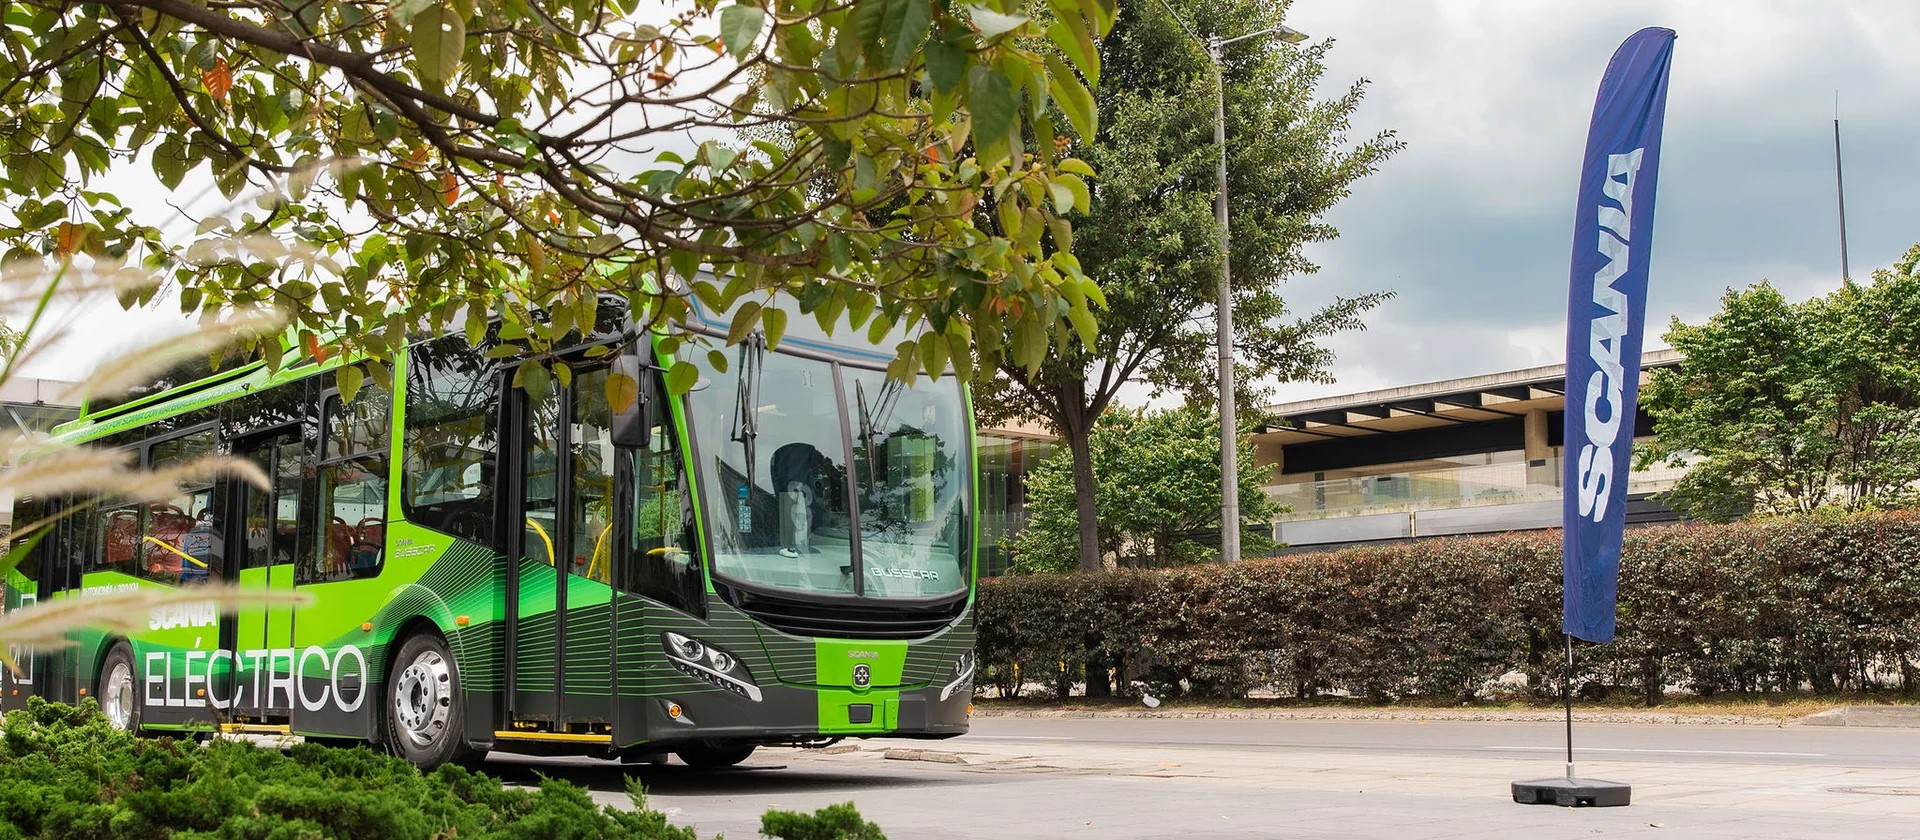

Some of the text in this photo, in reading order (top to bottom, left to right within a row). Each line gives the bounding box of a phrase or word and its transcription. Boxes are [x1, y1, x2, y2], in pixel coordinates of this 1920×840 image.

[1578, 147, 1644, 523] SCANIA
[869, 567, 940, 581] BUSSCAR
[149, 600, 217, 631] SCANIA
[848, 650, 879, 659] SCANIA
